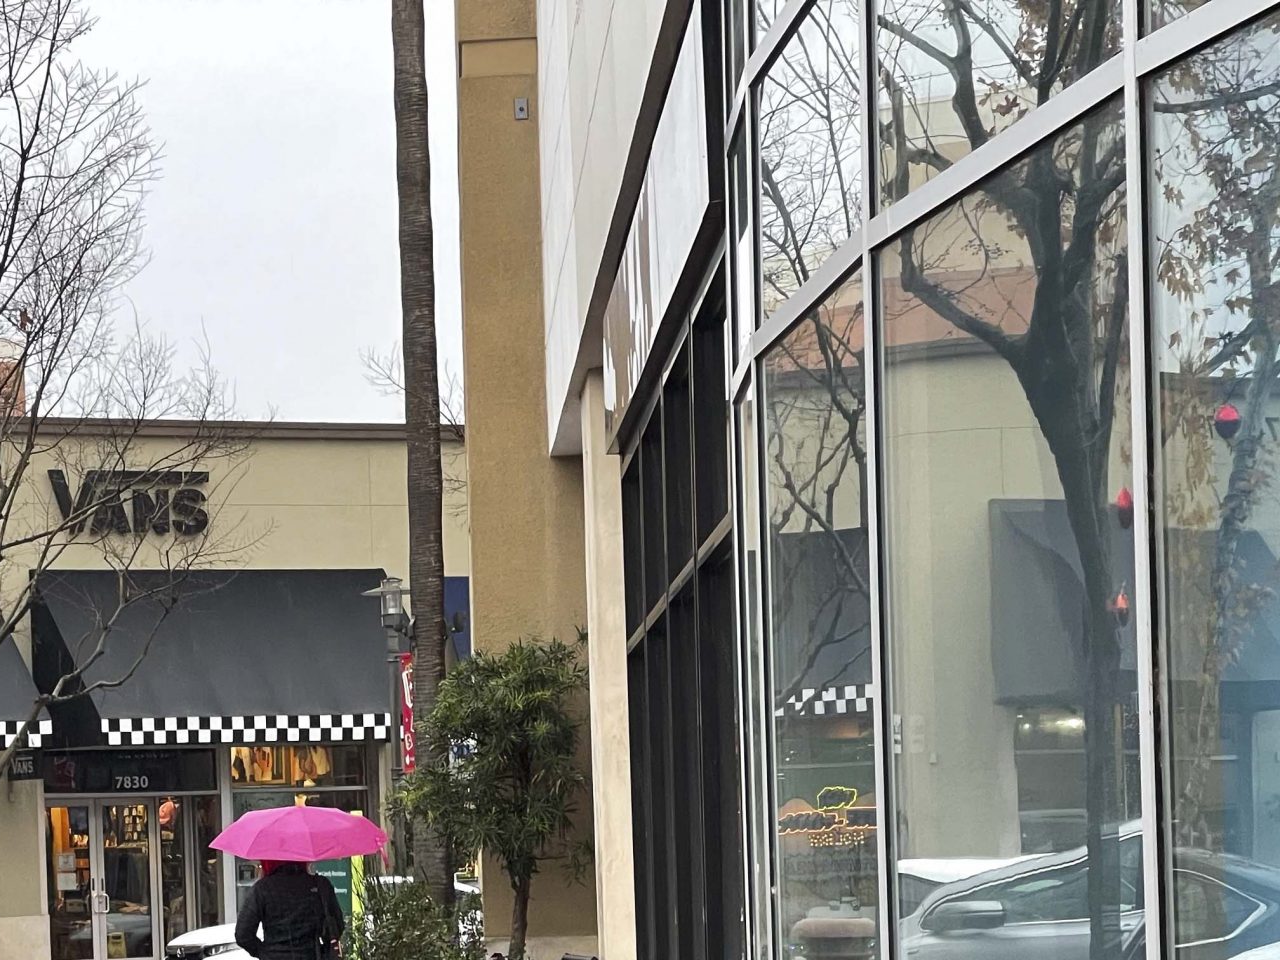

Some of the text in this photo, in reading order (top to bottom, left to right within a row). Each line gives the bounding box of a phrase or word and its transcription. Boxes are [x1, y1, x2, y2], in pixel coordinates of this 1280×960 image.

[47, 469, 210, 536] VANS
[10, 756, 34, 775] VANS
[115, 775, 149, 789] 7830
